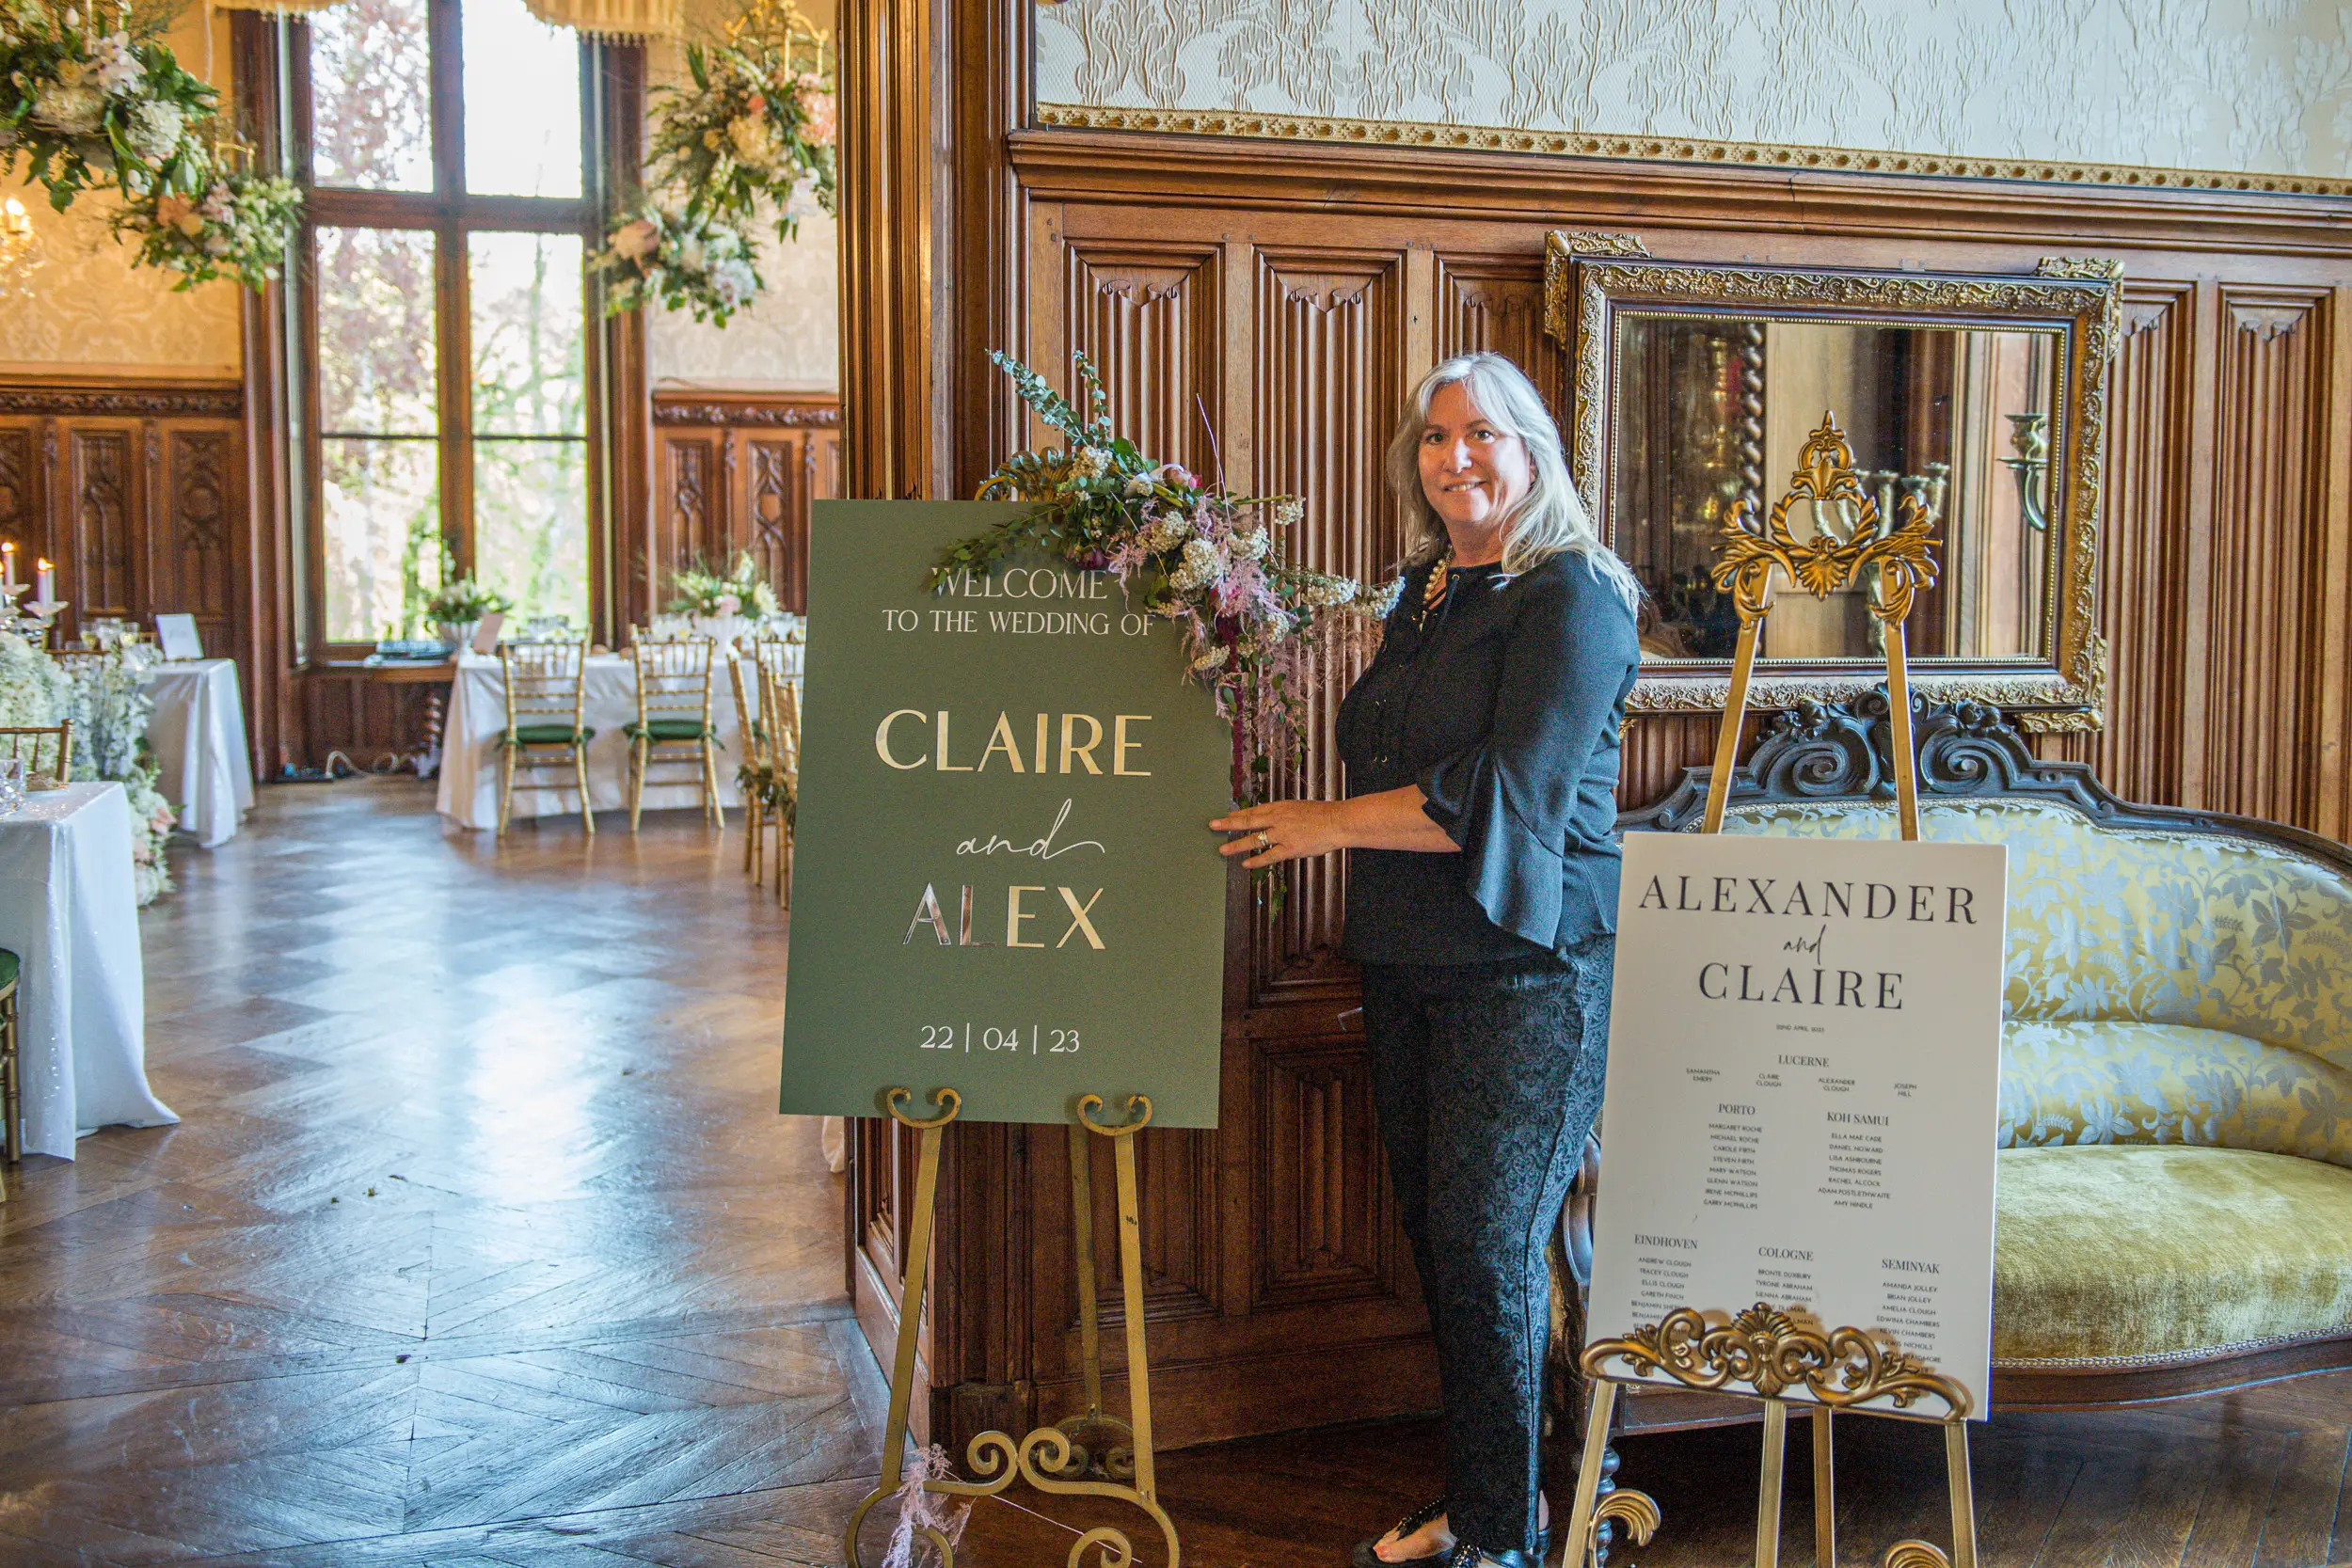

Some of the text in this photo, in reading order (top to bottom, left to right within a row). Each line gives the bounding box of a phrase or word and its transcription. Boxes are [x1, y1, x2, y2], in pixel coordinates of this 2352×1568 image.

[931, 567, 1108, 599] WELCOME
[882, 610, 1155, 636] TO THE WEDDING OF
[875, 708, 1153, 777] CLAIRE
[956, 798, 1105, 860] and
[1638, 874, 1978, 925] ALEXANDER
[901, 881, 1106, 950] ALEX
[1782, 924, 1827, 965] and
[1698, 961, 1903, 1010] CLAIRE
[1778, 1054, 1830, 1068] LUCERNE
[1686, 1068, 1721, 1076] SAMANTHA
[1818, 1077, 1855, 1085] ALEXANDER
[1718, 1102, 1756, 1116] PORTO
[1827, 1111, 1890, 1127] KOH SAMUI
[1708, 1122, 1762, 1133] MARGARET ROCHE
[1853, 1146, 1883, 1154] HOWARD
[1845, 1156, 1883, 1165] ASHBOURNE
[1829, 1165, 1882, 1176] THOMAS ROGERS
[1828, 1177, 1881, 1187] RACHEL ALCOCK
[1634, 1234, 1699, 1250] EINDHOVEN
[1758, 1246, 1814, 1261] COLOGNE
[1638, 1257, 1692, 1268] ANDREW CLOUGH
[1882, 1259, 1940, 1275] SEMINYAK
[1640, 1267, 1689, 1278] TRACEY CLOUGH
[1757, 1268, 1811, 1279] BRONTE DUXBURY
[1641, 1278, 1685, 1290] ELLIS CLOUGH
[1756, 1279, 1813, 1291] TYRONE ABRAHAM
[1882, 1282, 1938, 1293] AMANDA JOLLEY
[1641, 1290, 1664, 1298] GARETH
[1756, 1291, 1812, 1302] SIENNA ABRAHAM
[1908, 1295, 1931, 1304] JOLLEY
[1630, 1300, 1661, 1309] BENJAMIN
[1631, 1311, 1663, 1320] BENJAMIN
[1882, 1305, 1936, 1316] AMELIA CLOUGH
[1876, 1315, 1940, 1328] EDWINA CHAMBERS
[1879, 1327, 1936, 1339] KEVIN CHAMBERS
[1903, 1341, 1933, 1351] NICHOLS
